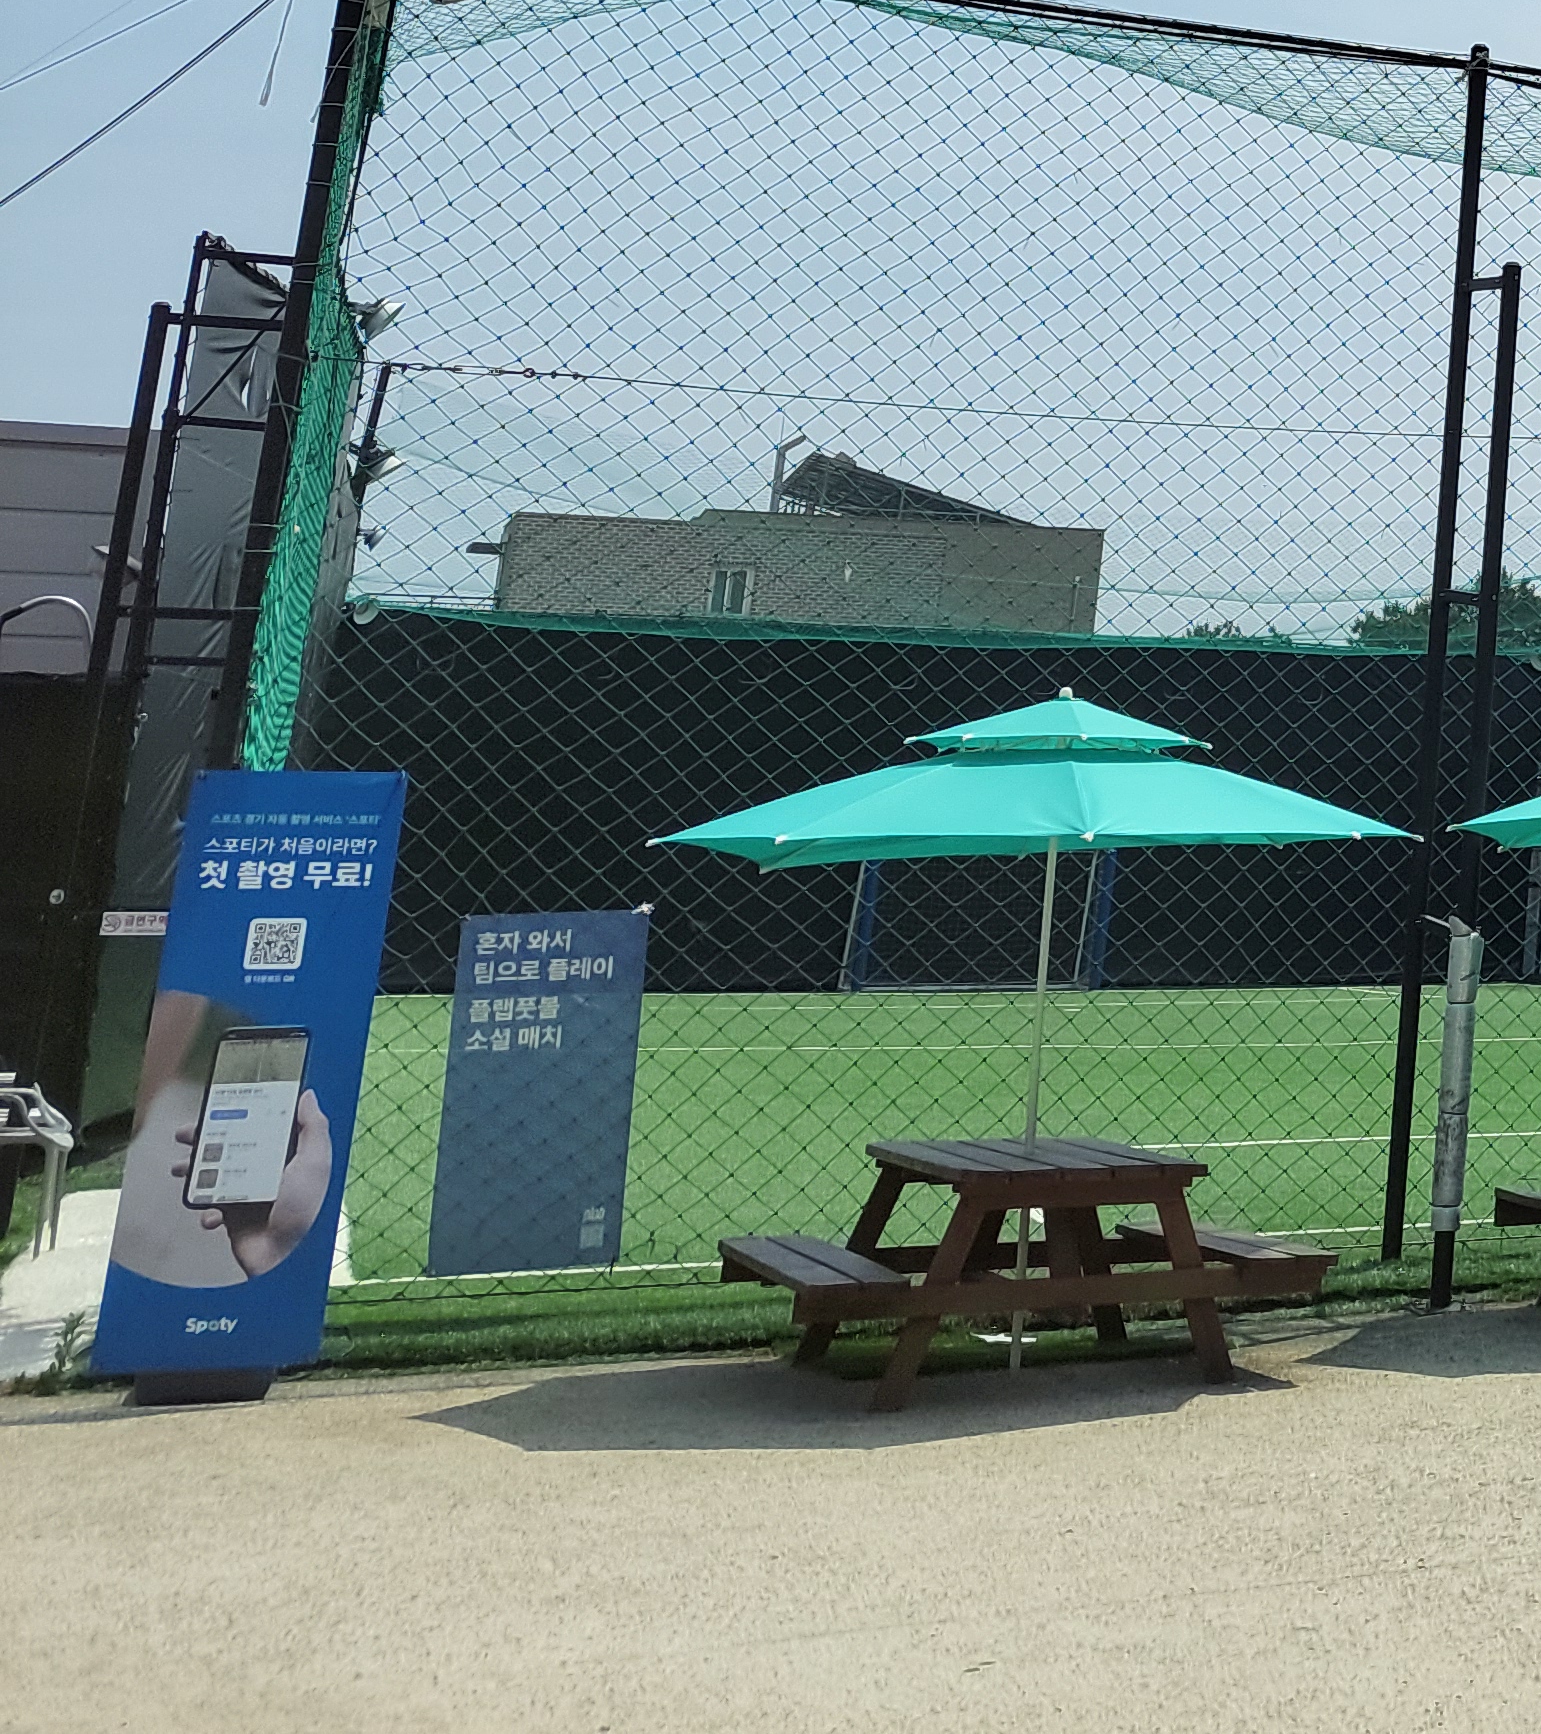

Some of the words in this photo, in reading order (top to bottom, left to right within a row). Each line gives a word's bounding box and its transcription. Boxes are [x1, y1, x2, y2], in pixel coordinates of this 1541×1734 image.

[202, 837, 277, 855] 스포티가
[279, 836, 378, 856] 처음이라면?
[198, 859, 229, 890] 첫
[236, 860, 298, 890] 촬영
[303, 861, 373, 890] 무료!
[475, 930, 522, 956] 혼자
[526, 928, 573, 954] 와서
[473, 959, 541, 985] 팀으로
[548, 954, 614, 982] 플레이
[517, 1024, 563, 1050] 매치
[184, 1315, 239, 1335] Spoty
